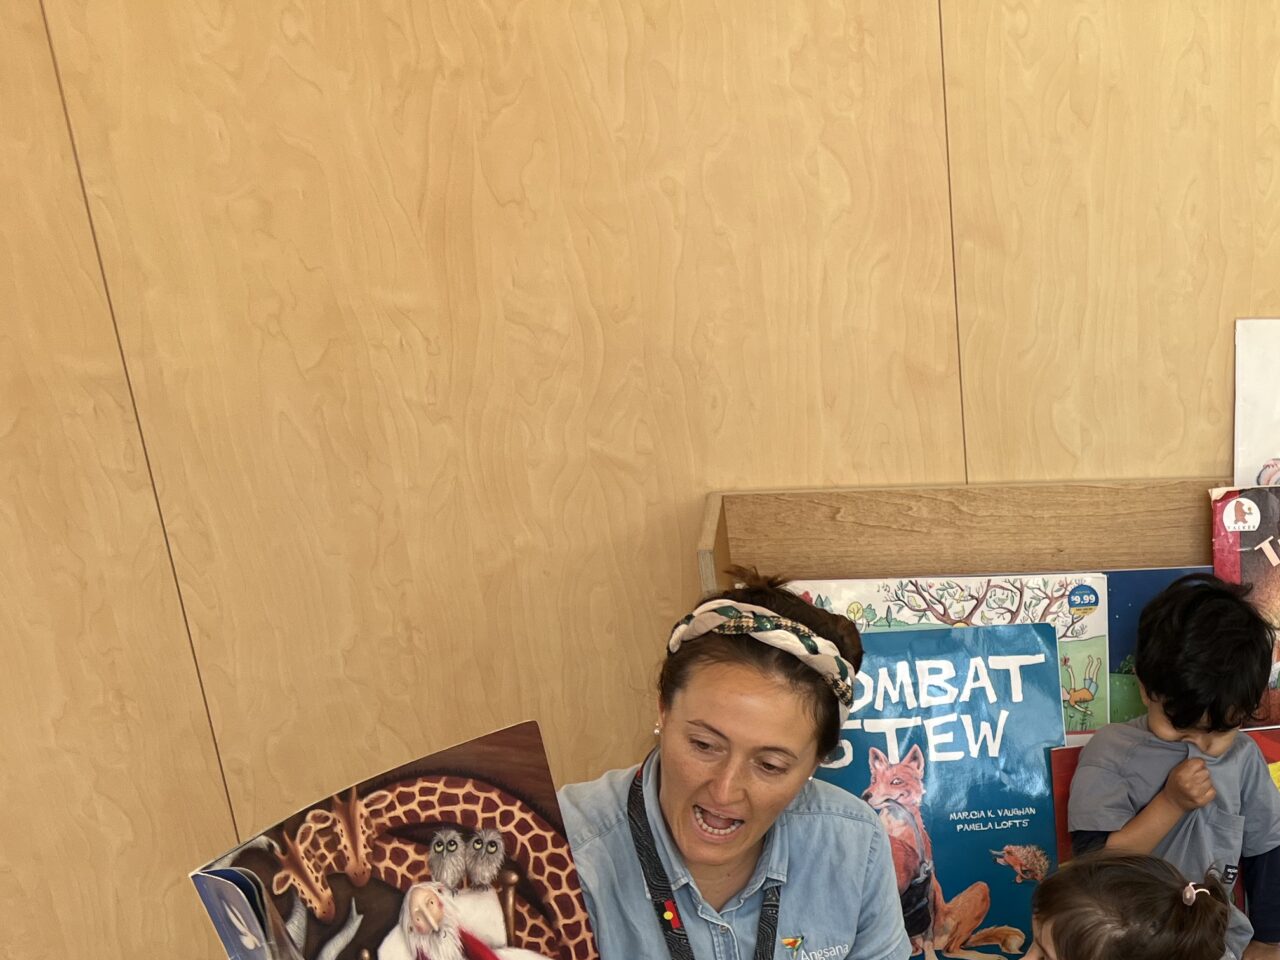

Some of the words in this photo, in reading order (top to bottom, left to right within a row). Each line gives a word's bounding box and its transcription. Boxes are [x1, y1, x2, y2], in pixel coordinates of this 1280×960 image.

[850, 654, 1045, 713] OMBAT
[997, 807, 1036, 817] VAUGHAN
[956, 822, 993, 832] PAMELA
[995, 819, 1030, 830] LOFTS
